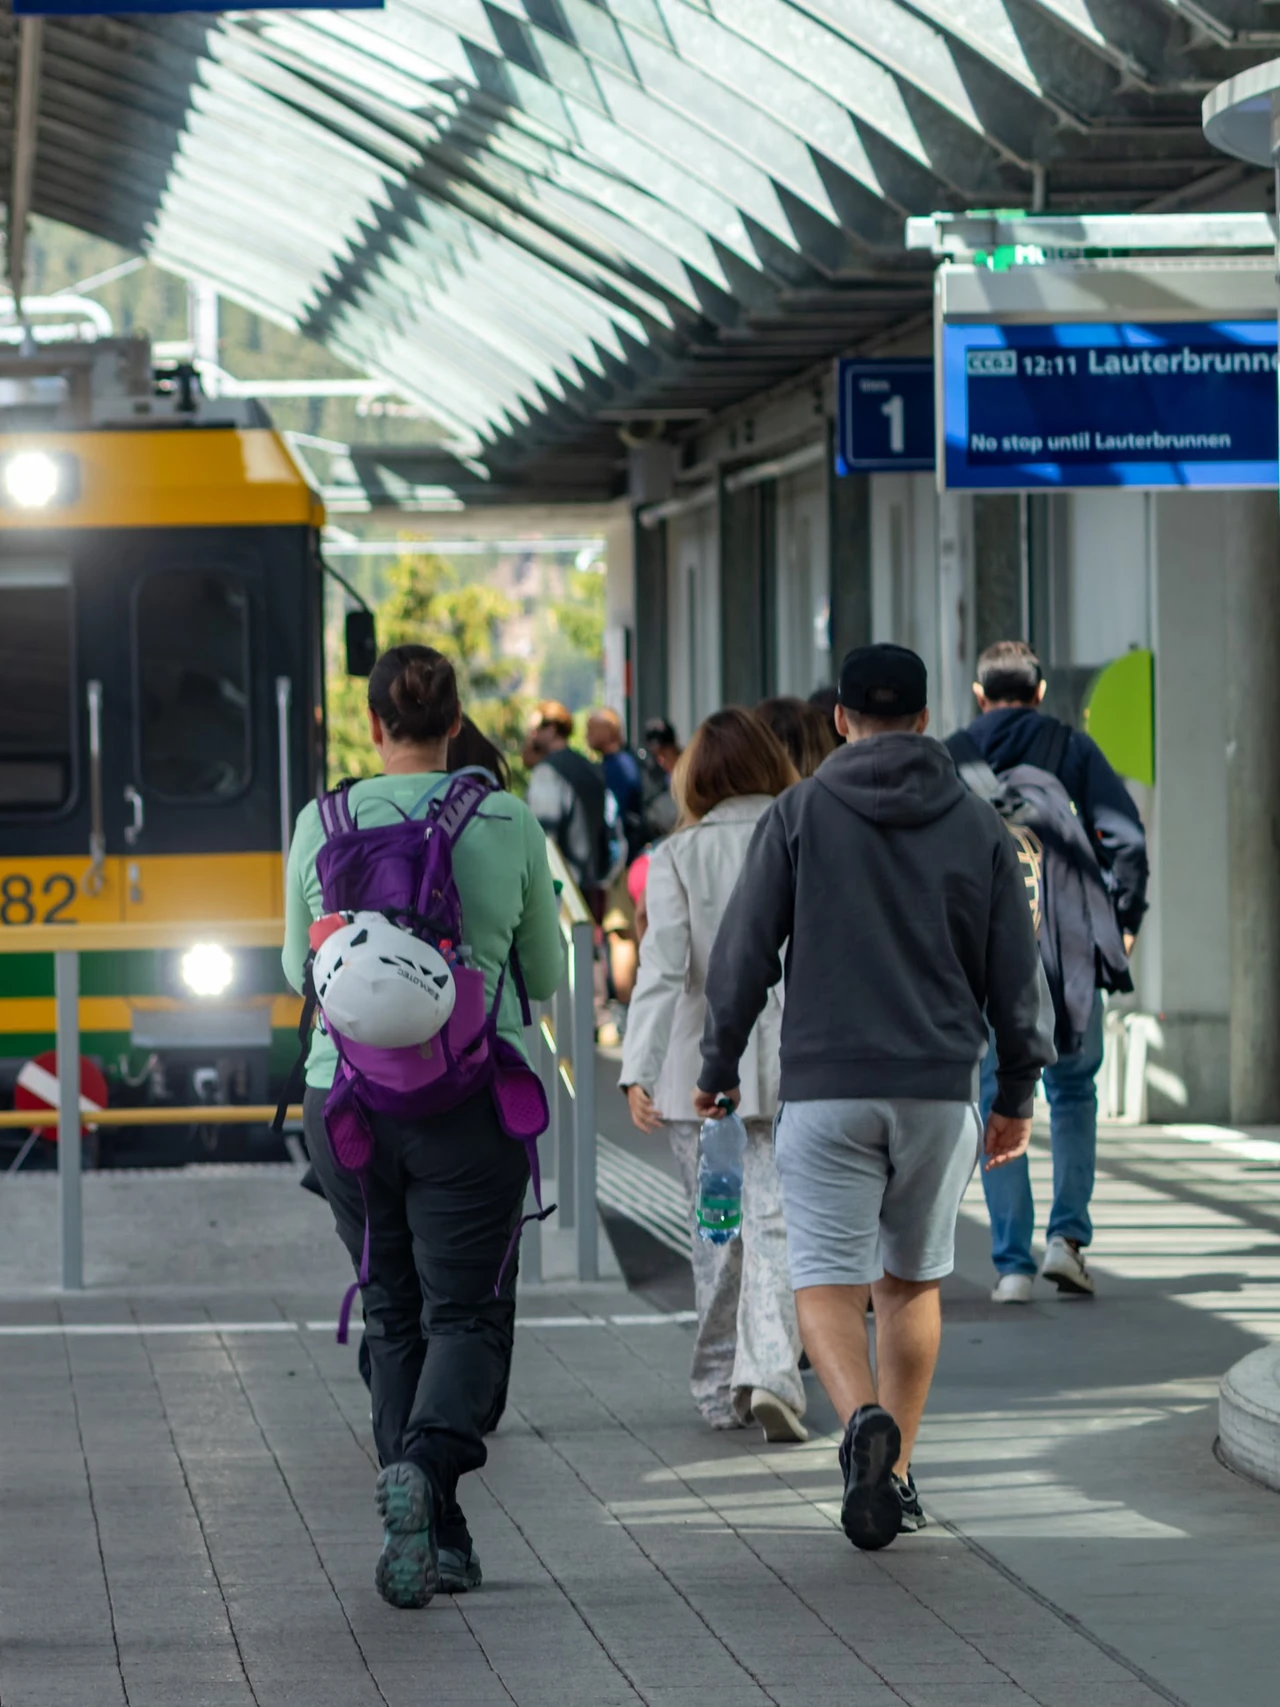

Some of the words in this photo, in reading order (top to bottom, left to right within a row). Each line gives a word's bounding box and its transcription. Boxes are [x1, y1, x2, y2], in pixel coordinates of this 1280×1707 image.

[1023, 355, 1077, 376] 12:11
[881, 395, 904, 453] 1
[971, 433, 998, 451] No
[1002, 434, 1043, 455] stop
[1048, 431, 1090, 450] until
[1095, 430, 1232, 450] Lauterbrunnen
